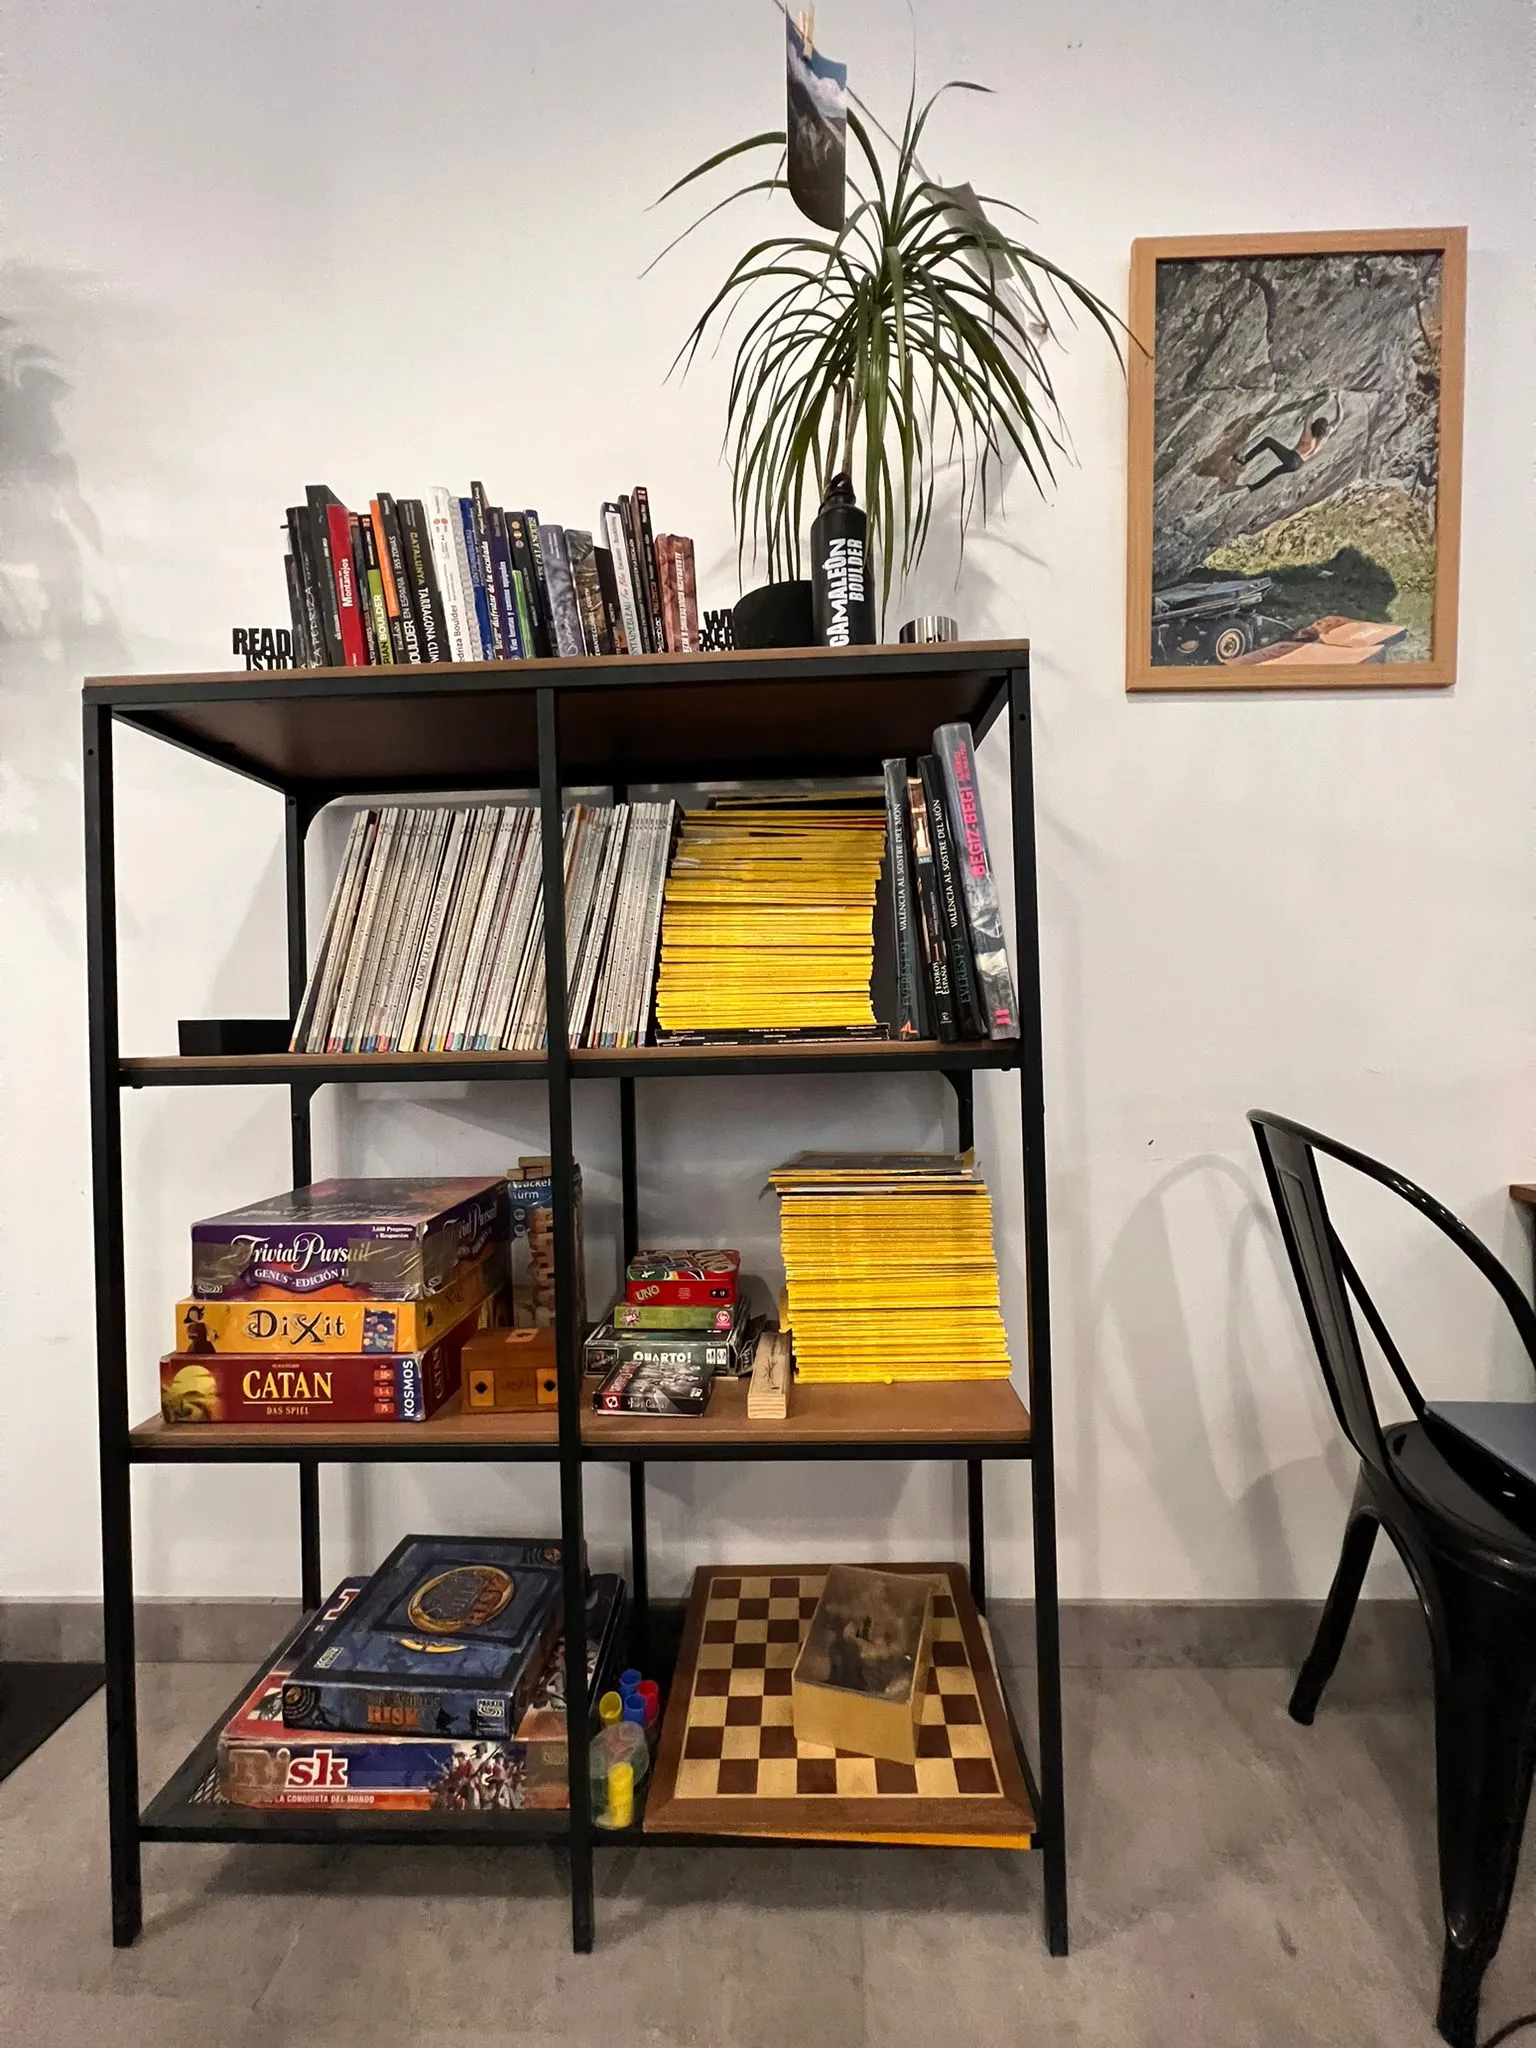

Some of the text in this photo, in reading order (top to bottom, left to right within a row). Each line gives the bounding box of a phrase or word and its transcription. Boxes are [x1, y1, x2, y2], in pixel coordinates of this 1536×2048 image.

[389, 536, 401, 557] ZONAS
[482, 541, 493, 571] escalada
[342, 558, 354, 607] Montanejos
[847, 539, 865, 602] BOULDER
[410, 532, 424, 584] CATALUNYA
[418, 587, 436, 641] TARRAGONA
[488, 581, 495, 594] de
[822, 537, 850, 647] CAMALEÓN
[305, 586, 320, 645] PEDRIZA
[372, 594, 388, 641] BOULDER
[402, 609, 411, 619] EN
[450, 605, 461, 637] Boulder
[491, 594, 500, 628] disfrutar
[933, 800, 942, 821] MÓN
[895, 828, 903, 842] DEL
[937, 823, 945, 839] DEL
[896, 844, 904, 875] SOSTRE
[939, 840, 950, 871] SOSTRE
[231, 1232, 371, 1272] Trivial Pursuit
[254, 1268, 288, 1284] GENUS
[634, 1284, 660, 1303] UNO
[632, 1351, 692, 1364] QUARTO!
[242, 1370, 333, 1400] CATAN
[402, 1360, 415, 1417] KOSMOS
[266, 1406, 310, 1416] DAS SPIEL
[367, 1705, 418, 1725] RISK
[228, 1748, 348, 1788] Risk
[287, 1795, 329, 1803] CONQUISTA
[331, 1795, 344, 1803] DEL
[347, 1794, 375, 1803] MUNDO
